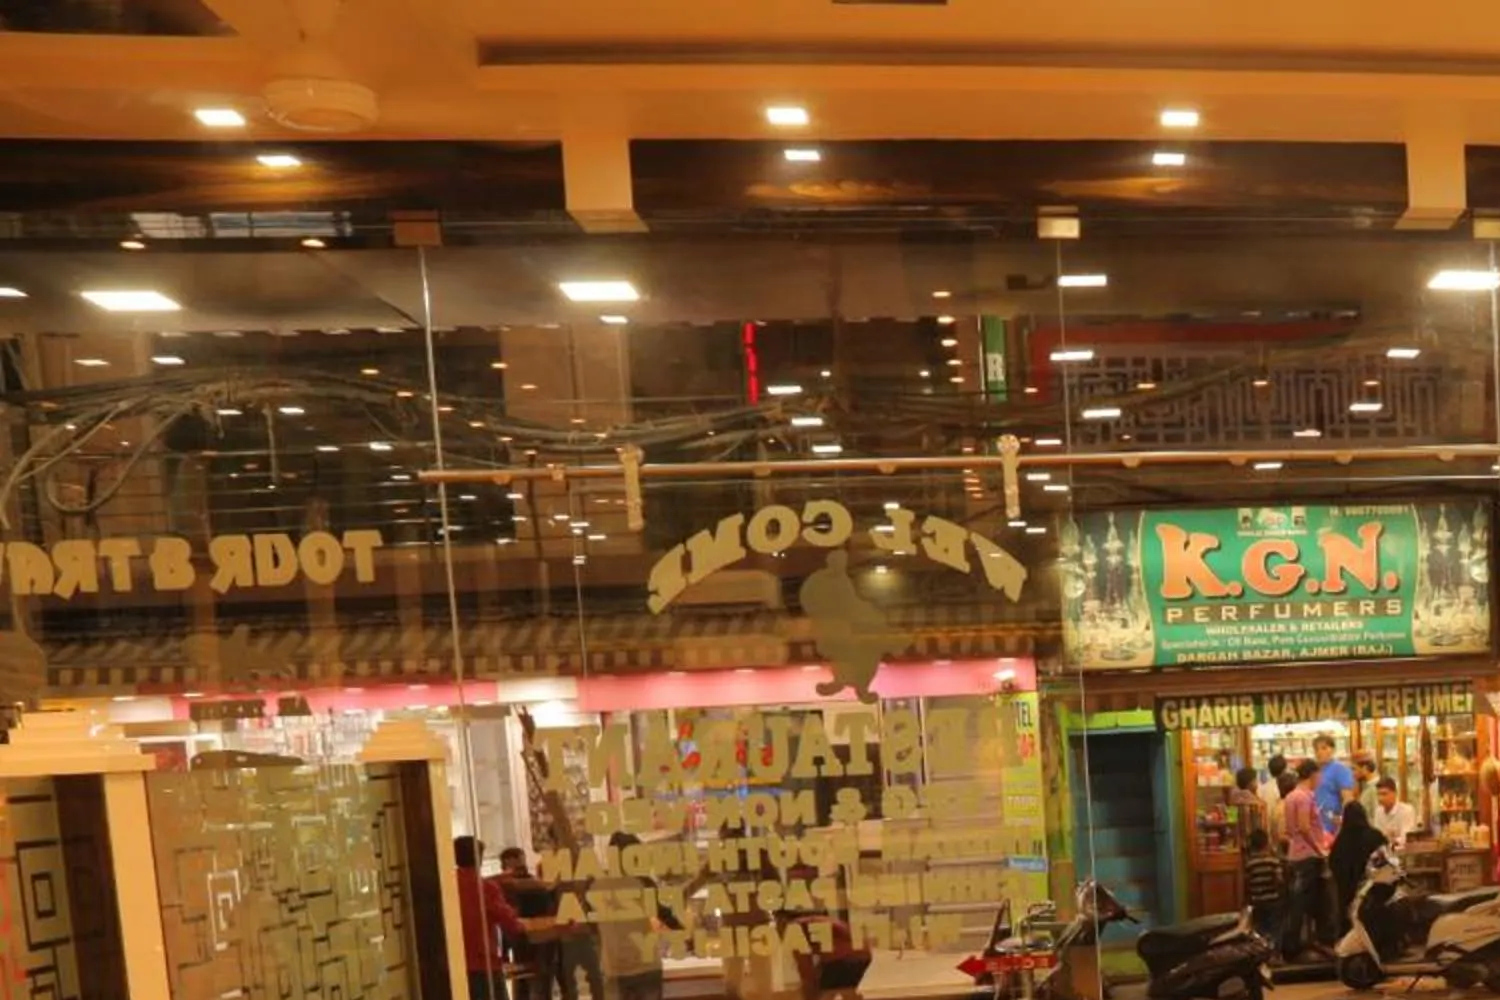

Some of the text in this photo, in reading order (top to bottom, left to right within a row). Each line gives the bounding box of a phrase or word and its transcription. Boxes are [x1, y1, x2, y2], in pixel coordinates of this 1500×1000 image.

[1155, 521, 1399, 600] K.G.N.
[1166, 600, 1402, 623] PERFUMERS
[1299, 646, 1348, 658] AJMER
[1162, 697, 1256, 729] GHARIB
[1262, 690, 1348, 724] NAWAZ
